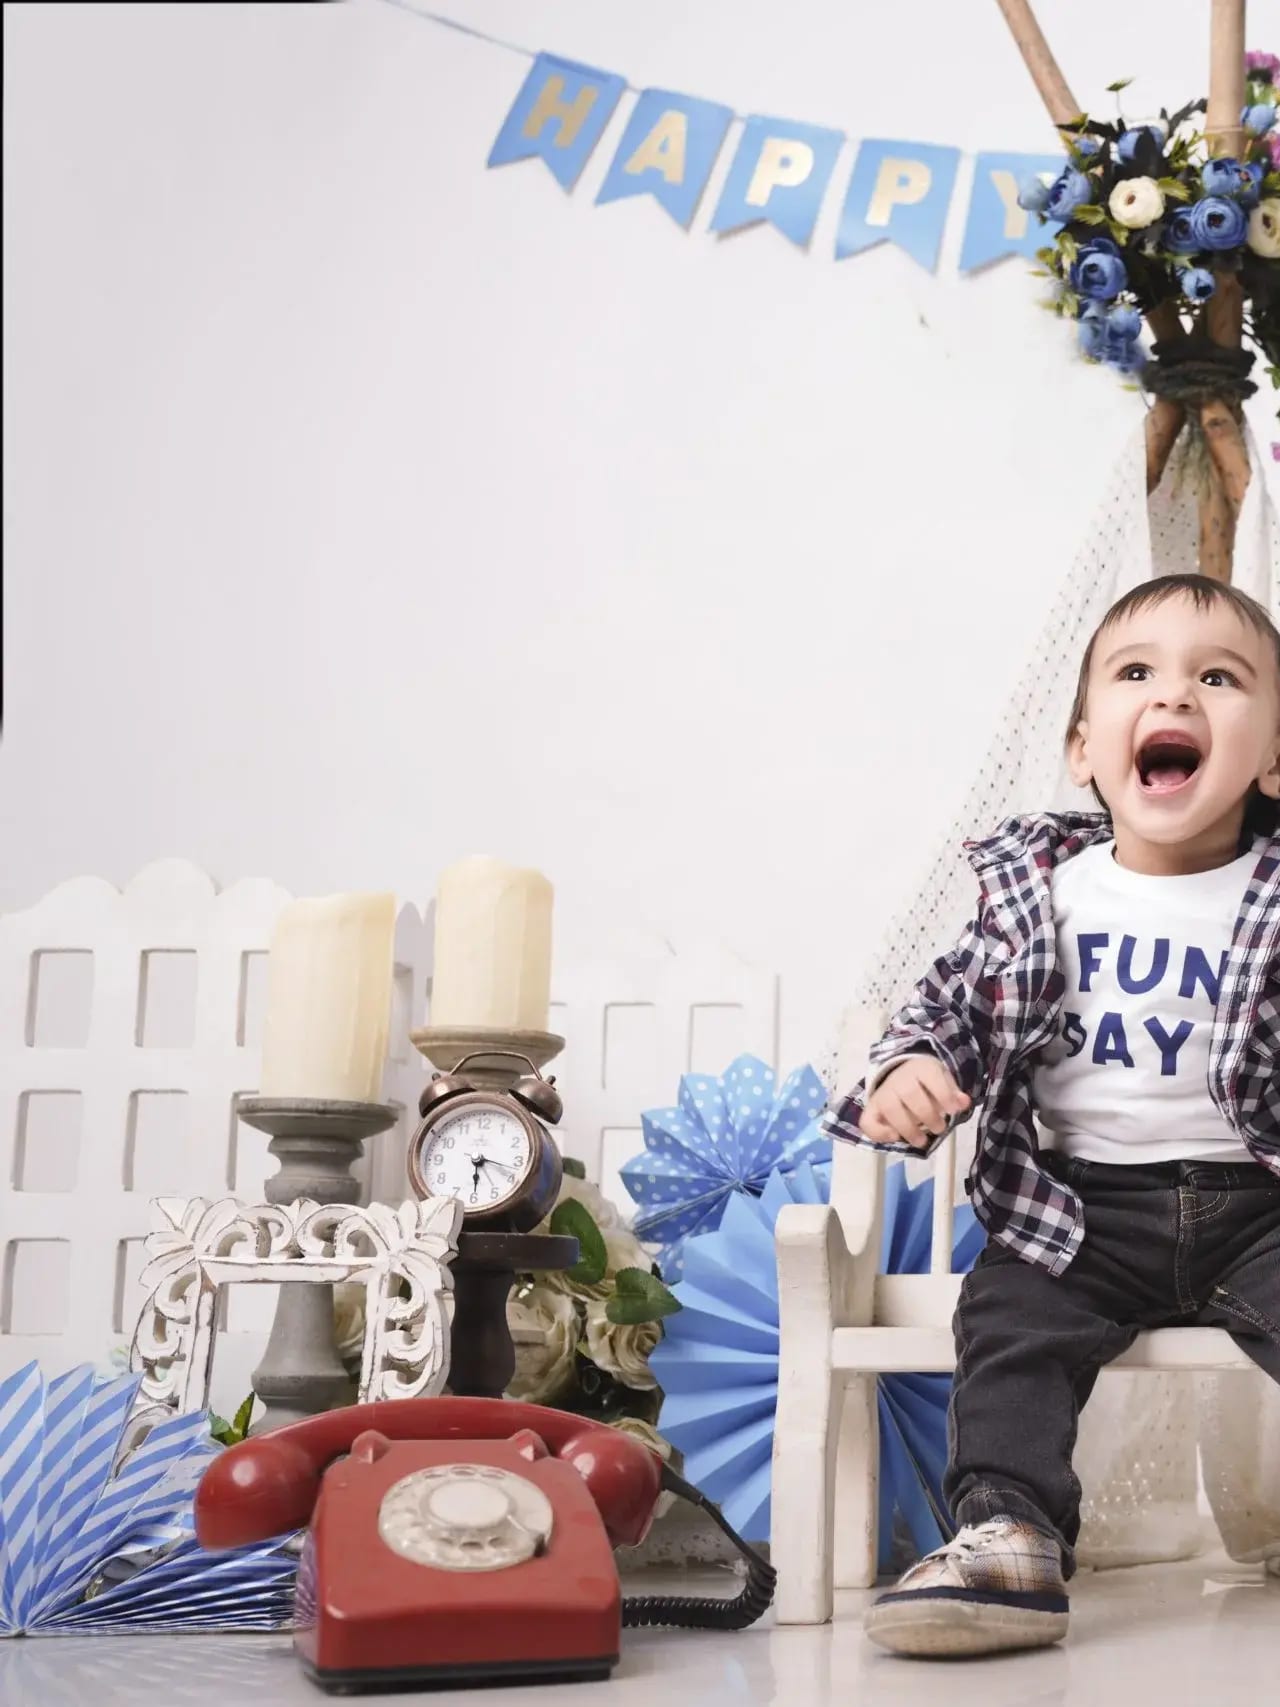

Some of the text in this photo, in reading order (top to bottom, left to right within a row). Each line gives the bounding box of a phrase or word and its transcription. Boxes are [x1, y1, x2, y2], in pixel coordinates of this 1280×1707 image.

[522, 73, 1057, 239] HAPPY
[1077, 933, 1229, 1006] FUN
[458, 1123, 470, 1135] 11
[478, 1118, 491, 1130] 12
[500, 1123, 506, 1134] 1
[442, 1138, 455, 1149] 10
[511, 1137, 520, 1148] 2
[434, 1154, 443, 1166] 9
[514, 1156, 523, 1167] 3
[437, 1173, 446, 1184] 8
[507, 1173, 515, 1183] 4
[453, 1187, 460, 1198] 7
[470, 1192, 479, 1204] 6
[490, 1187, 500, 1199] 5
